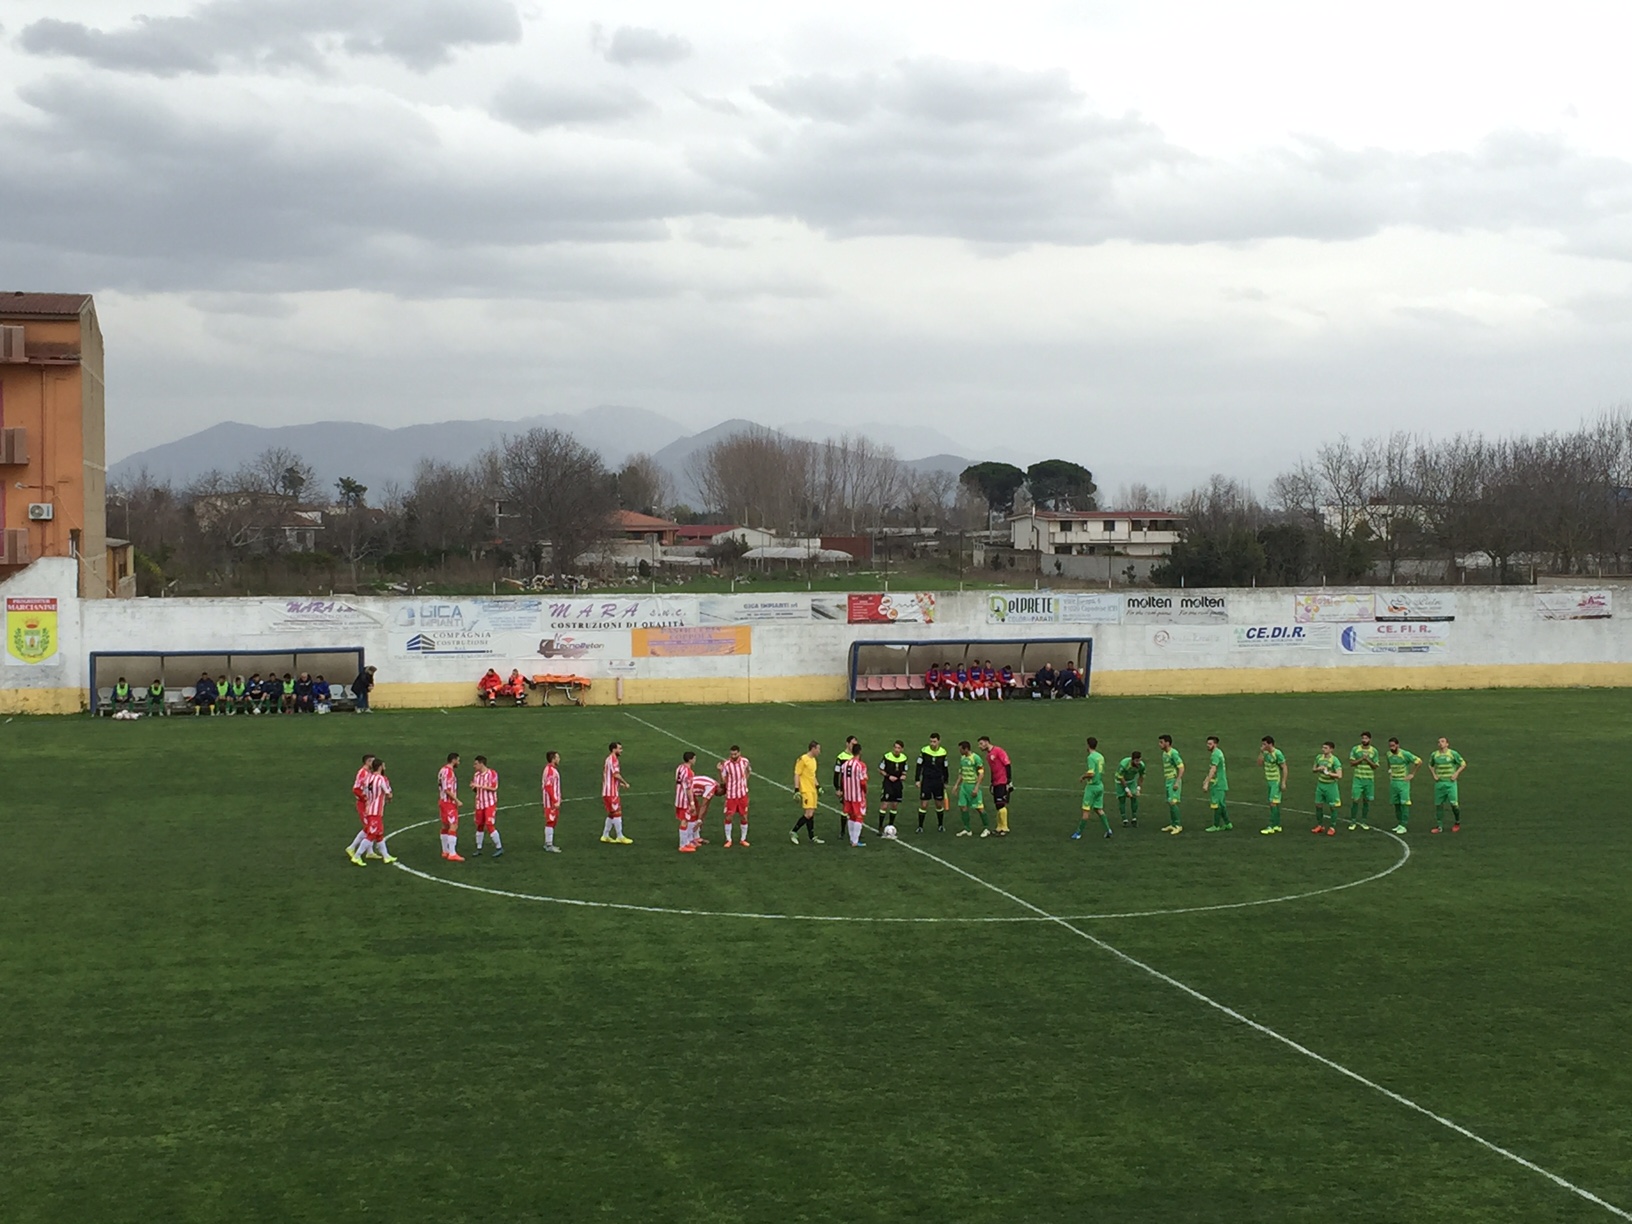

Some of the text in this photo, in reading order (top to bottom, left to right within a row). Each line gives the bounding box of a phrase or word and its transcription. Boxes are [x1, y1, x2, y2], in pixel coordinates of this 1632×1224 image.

[286, 602, 335, 613] MARA
[1127, 596, 1172, 609] molten
[1180, 596, 1225, 609] molten
[549, 602, 640, 619] MARA
[1246, 626, 1306, 639] CE.DI.R.
